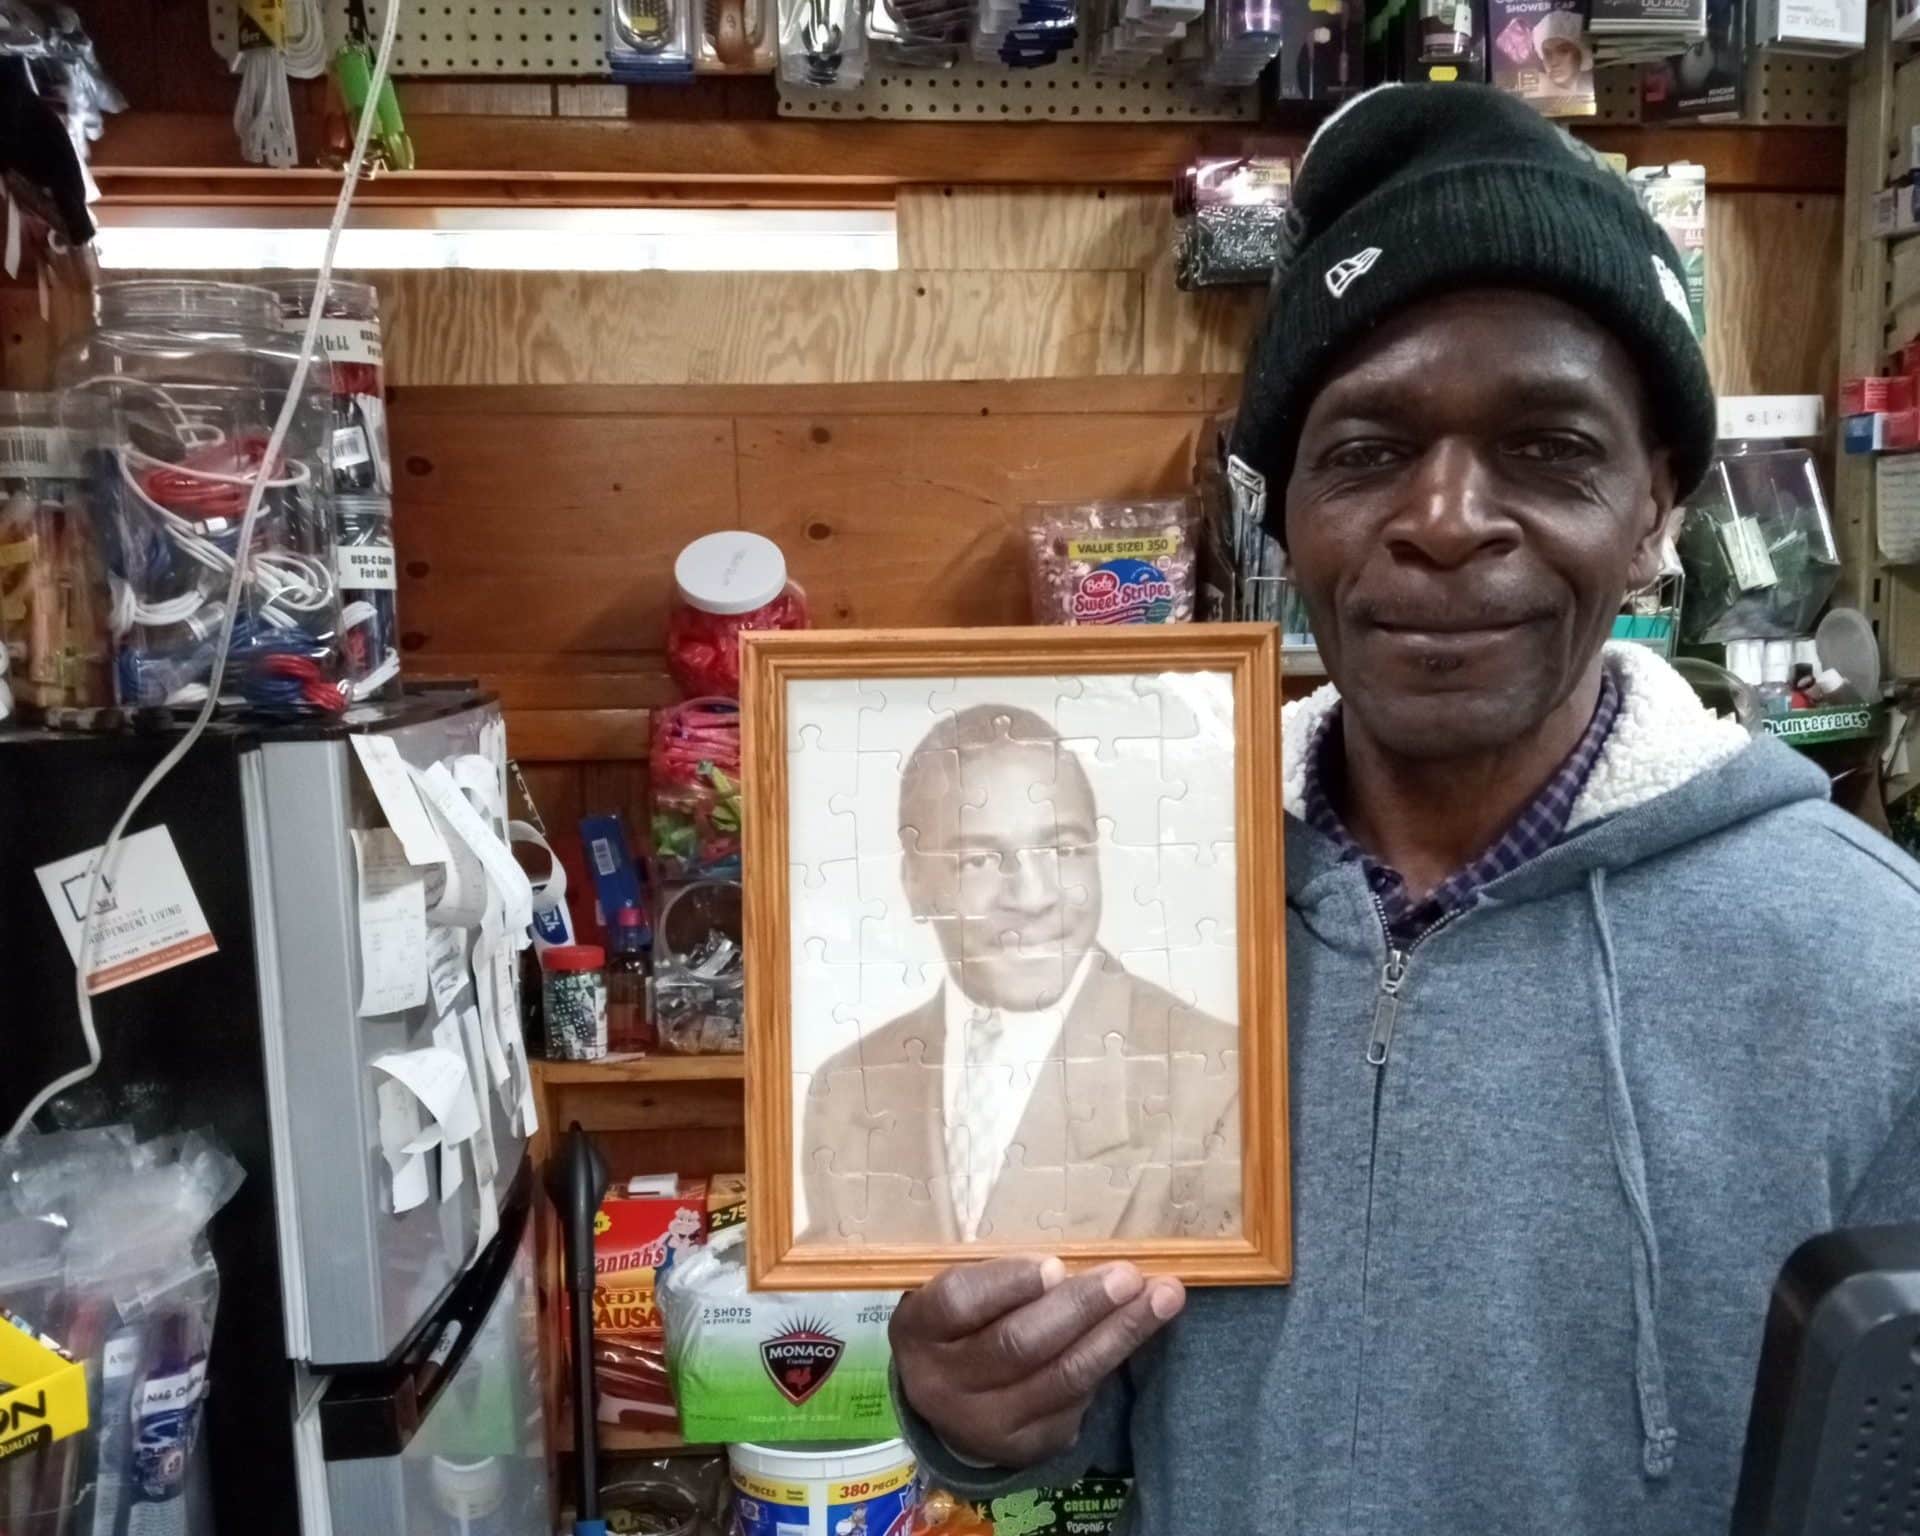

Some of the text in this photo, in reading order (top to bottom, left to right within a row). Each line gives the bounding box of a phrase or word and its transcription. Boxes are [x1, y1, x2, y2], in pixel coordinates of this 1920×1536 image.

[1505, 1, 1577, 13] SHOWER CAP
[1077, 543, 1114, 554] VALUE
[1147, 539, 1169, 551] 350
[351, 554, 376, 566] USB-C
[360, 567, 375, 579] For
[1075, 583, 1172, 614] Sweet Stripes
[150, 904, 183, 923] LIVING
[596, 1243, 665, 1274] annah's
[593, 1285, 636, 1306] RED
[594, 1307, 663, 1329] AUSA
[703, 1307, 752, 1319] 2 SHOTS
[856, 1311, 895, 1324] TEQUI
[769, 1345, 837, 1360] MONACO
[749, 1482, 777, 1498] PIECES
[840, 1477, 899, 1499] 380 PIECES
[1064, 1499, 1099, 1512] GREEN
